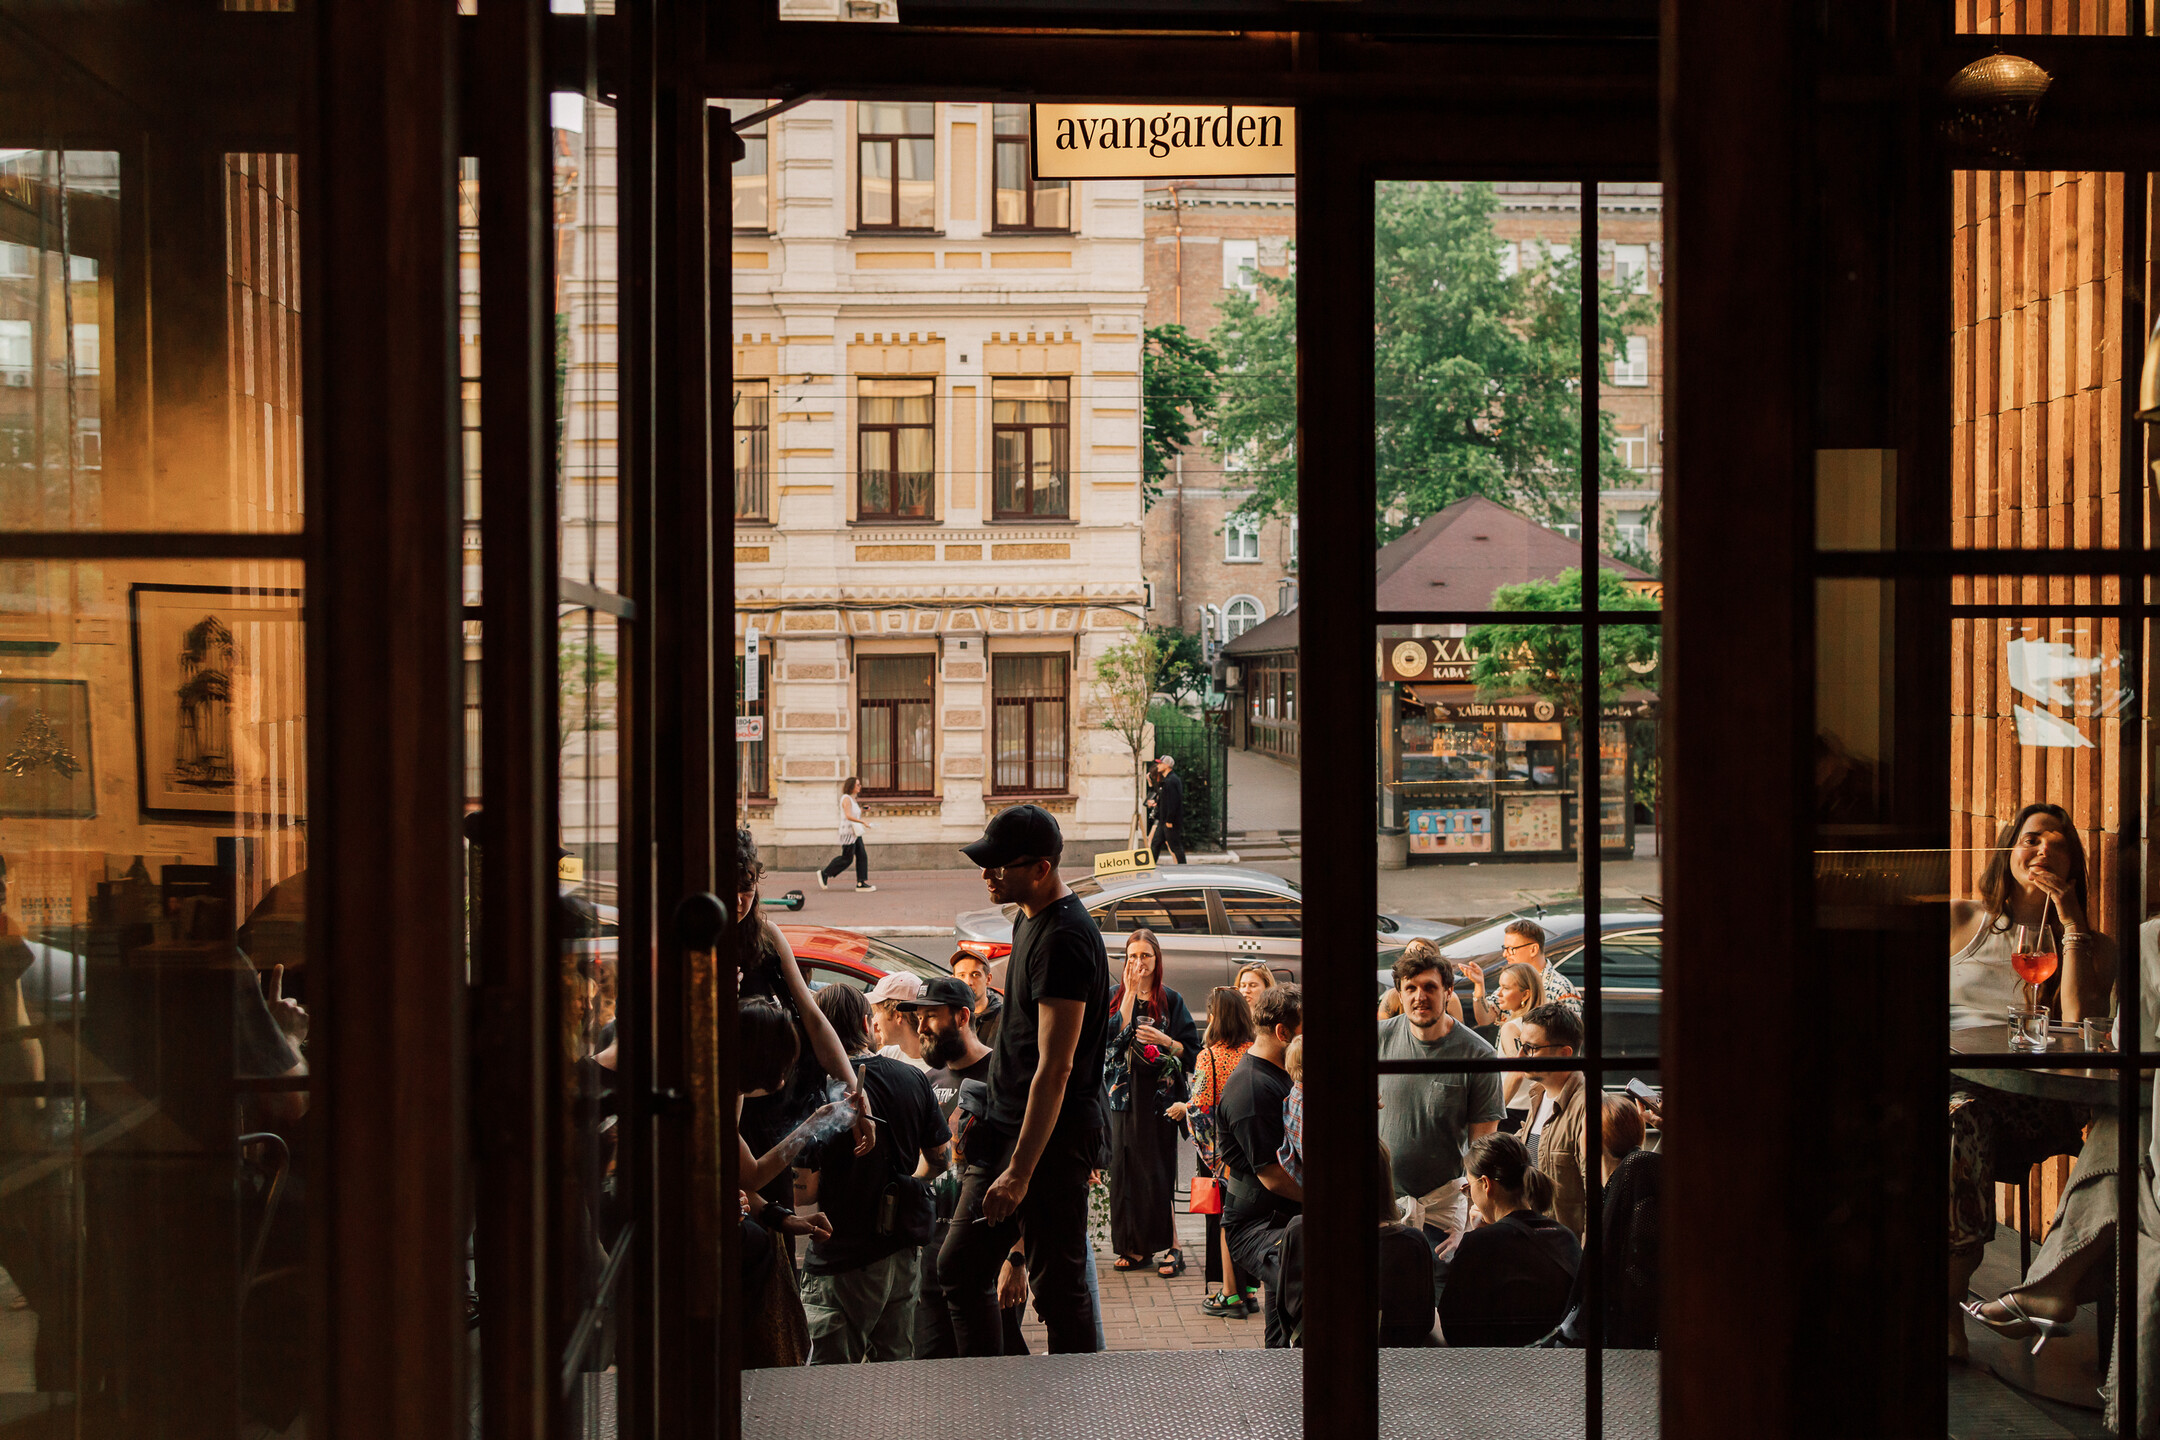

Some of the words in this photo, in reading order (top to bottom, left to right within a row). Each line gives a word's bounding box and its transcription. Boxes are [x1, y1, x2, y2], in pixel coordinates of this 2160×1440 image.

[1056, 106, 1283, 158] avangarden
[1433, 667, 1464, 678] КАВА
[1498, 704, 1527, 718] КАВА
[1099, 858, 1130, 868] uklon
